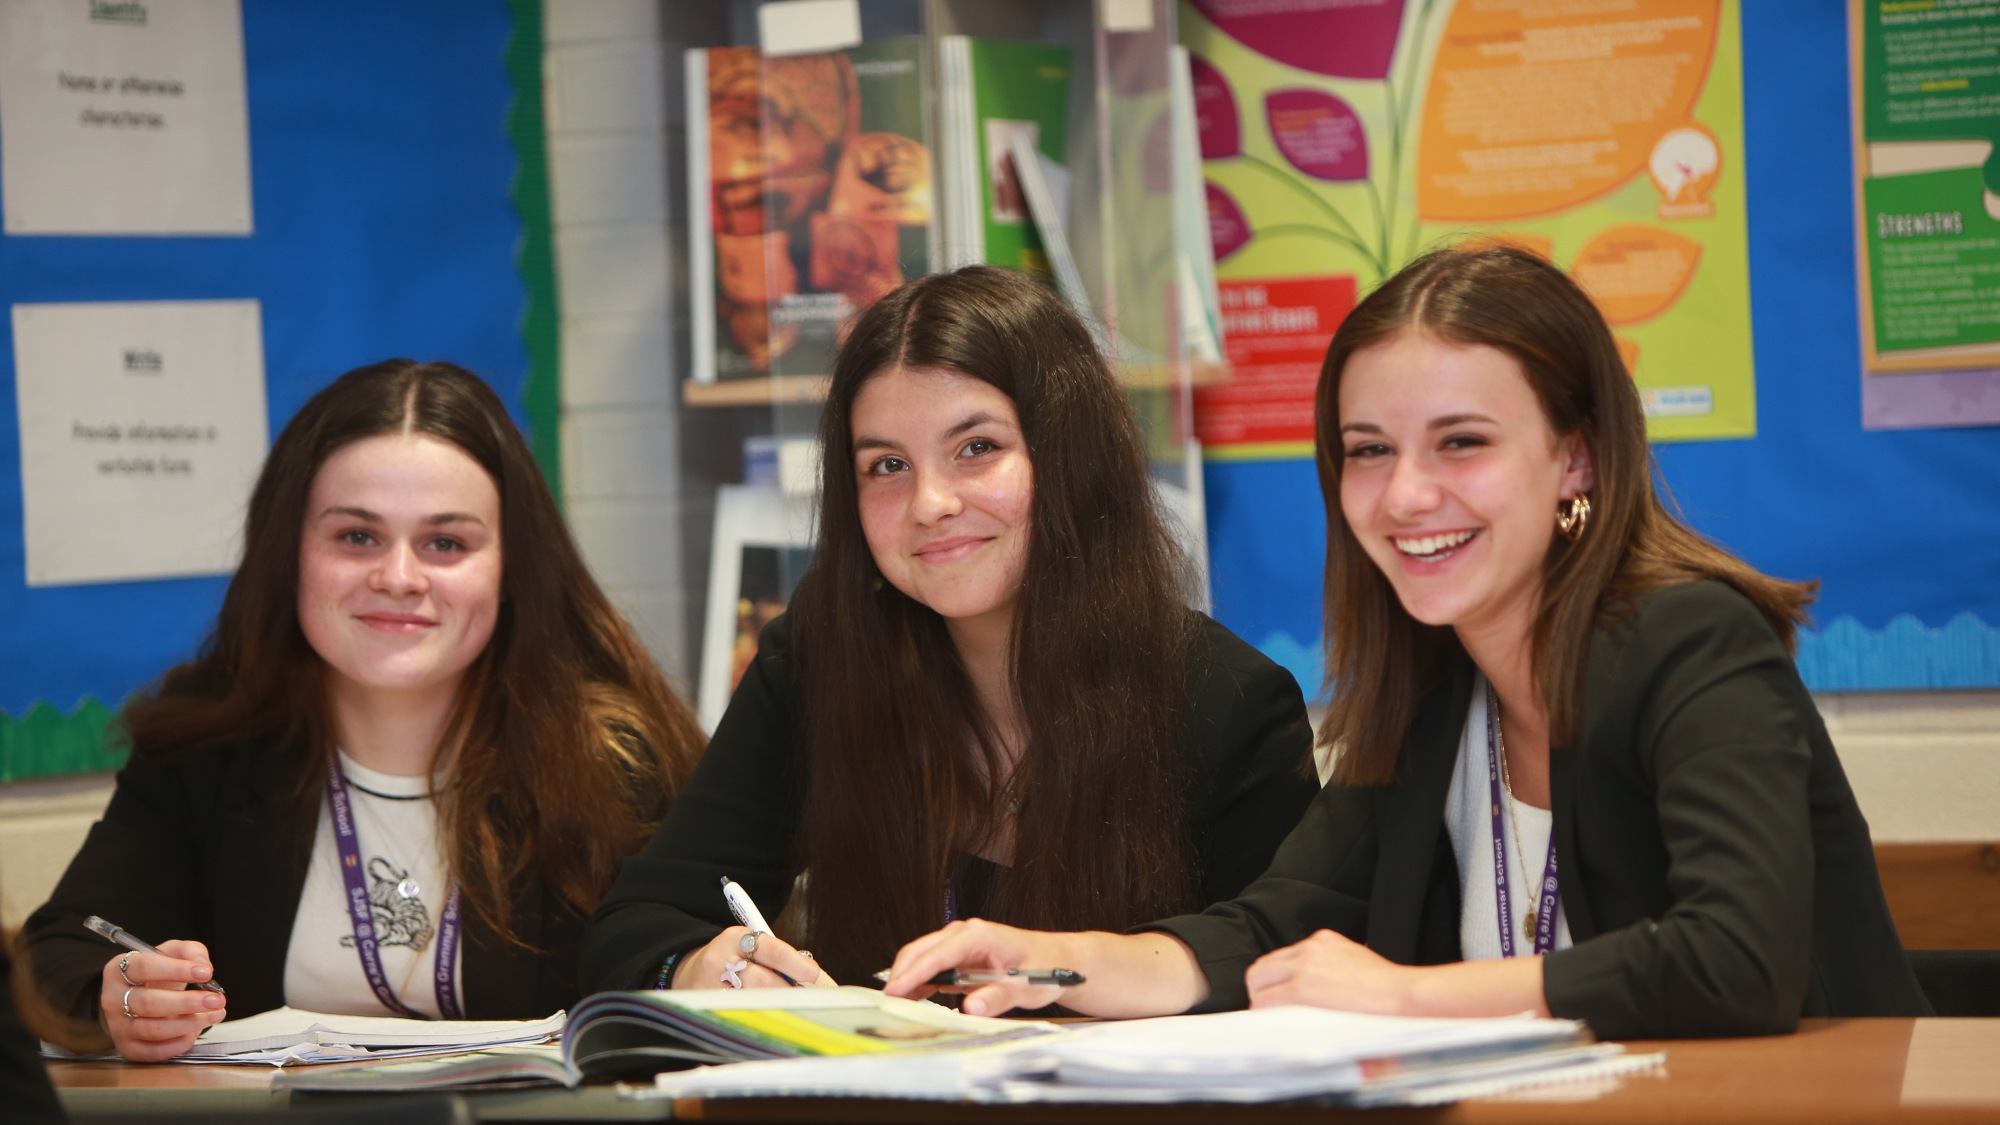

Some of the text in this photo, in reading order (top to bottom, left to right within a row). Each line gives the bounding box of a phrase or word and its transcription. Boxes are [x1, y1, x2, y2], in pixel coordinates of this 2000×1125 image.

[101, 76, 116, 92] or
[332, 791, 354, 837] School
[1494, 838, 1506, 885] School
[1545, 876, 1558, 892] @
[351, 887, 382, 986] SJSF @ Carre's
[1498, 889, 1511, 952] Grammar
[1539, 894, 1556, 945] Carre's
[436, 923, 455, 983] Grammar
